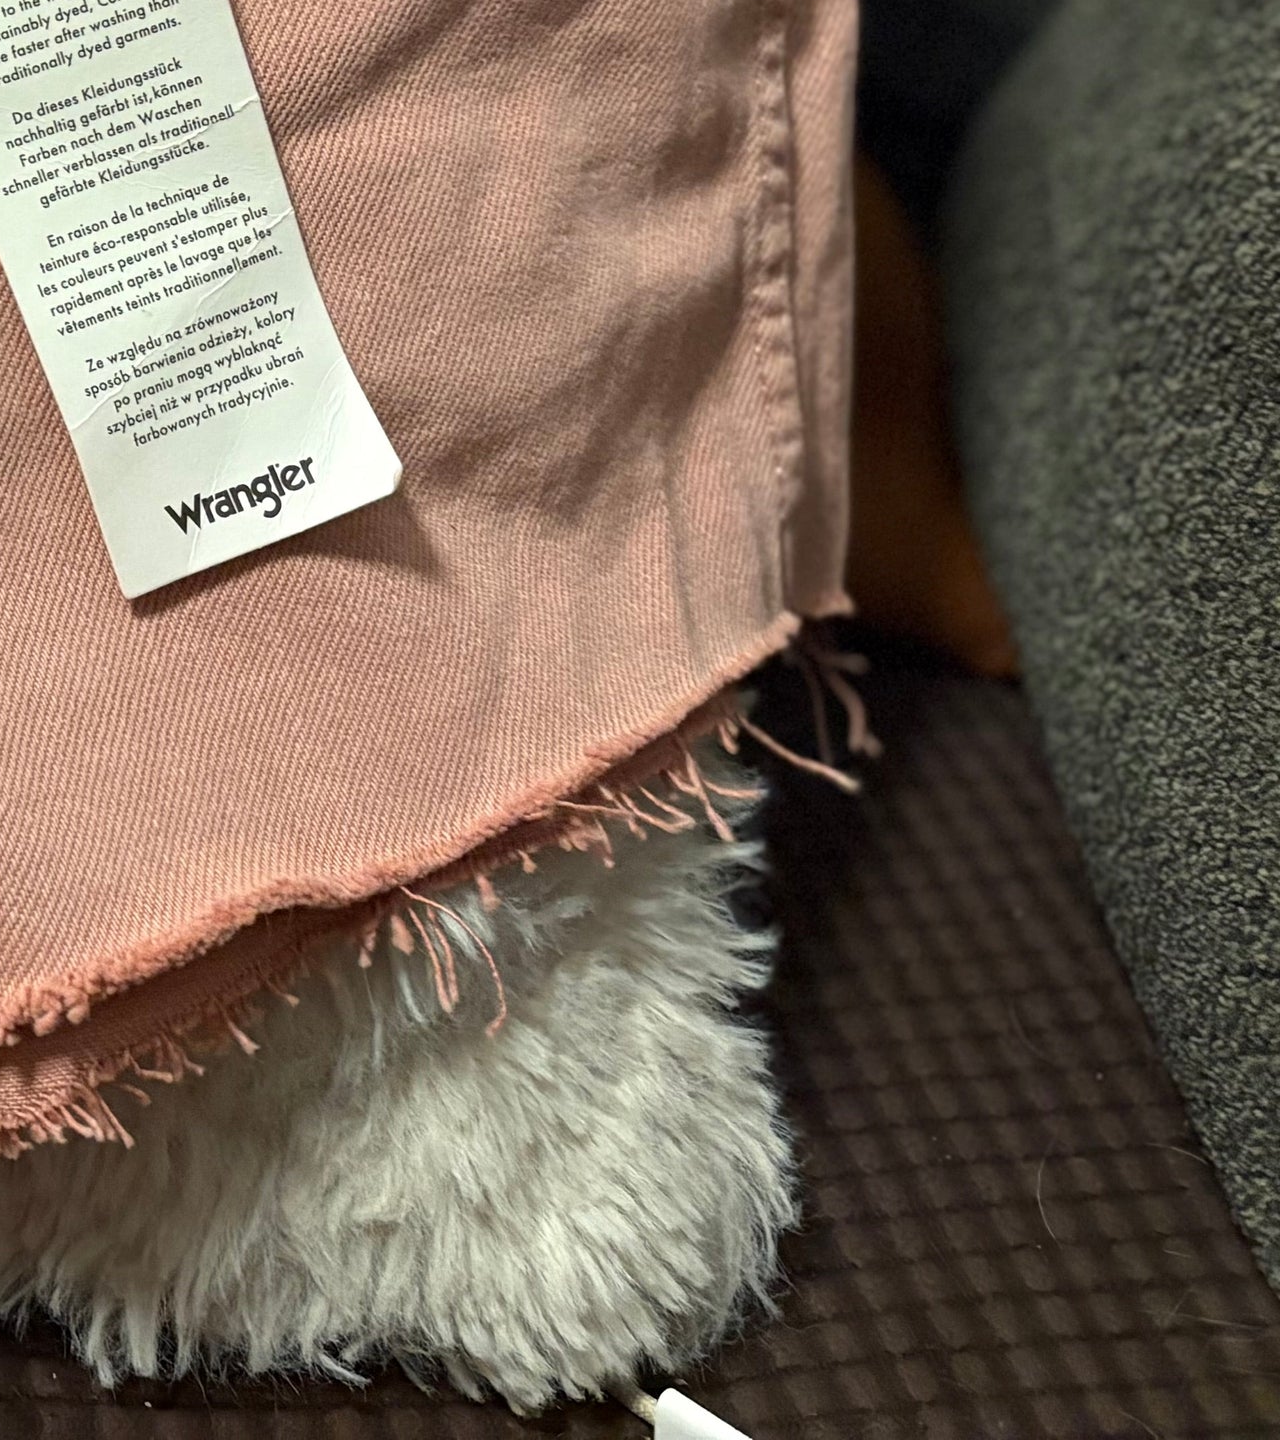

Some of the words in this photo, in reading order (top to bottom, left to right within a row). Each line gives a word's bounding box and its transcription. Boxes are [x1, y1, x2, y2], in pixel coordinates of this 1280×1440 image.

[0, 6, 16, 18] to
[10, 38, 51, 59] faster
[53, 26, 86, 45] after
[88, 6, 147, 33] washing
[77, 35, 113, 60] dyed
[115, 17, 182, 50] garments.
[5, 118, 77, 150] nachhaltig
[79, 97, 130, 128] gefärbt
[11, 111, 34, 126] Da
[36, 95, 80, 117] dieses
[80, 56, 183, 102] Kleidungsstück
[1, 168, 60, 197] schneller
[62, 143, 136, 174] verblassen
[137, 131, 159, 149] als
[159, 103, 236, 142] traditionell
[18, 144, 68, 168] Farben
[70, 128, 104, 151] nach
[106, 120, 137, 138] dem
[136, 98, 202, 126] Waschen
[39, 178, 96, 209] gefärbte
[97, 134, 210, 185] Kleidungsstücke.
[39, 249, 90, 274] teinture
[92, 207, 199, 255] éco-responsable
[200, 191, 251, 215] utilisée,
[46, 234, 66, 249] En
[67, 219, 109, 242] raison
[110, 210, 128, 225] de
[128, 204, 145, 219] la
[145, 183, 210, 213] technique
[212, 173, 230, 189] de
[36, 283, 59, 298] les
[60, 262, 116, 290] couleurs
[116, 240, 169, 273] peuvent
[170, 216, 238, 249] s'estomper
[241, 206, 268, 227] plus
[49, 280, 125, 317] rapidement
[126, 267, 164, 289] après
[163, 260, 179, 275] le
[178, 245, 225, 269] lavage
[227, 235, 252, 253] que
[252, 227, 272, 241] les
[56, 305, 124, 337] vêtements
[124, 291, 162, 312] teints
[162, 244, 283, 298] traditionnellement.
[84, 369, 132, 400] sposób
[131, 345, 197, 379] barwienia
[198, 325, 253, 353] odzieży,
[253, 307, 295, 330] kolory
[85, 358, 105, 373] Ze
[106, 335, 163, 365] względu
[164, 329, 183, 344] na
[184, 291, 278, 336] zrównoważony
[106, 403, 159, 435] szybciej
[159, 396, 180, 414] niż
[180, 393, 192, 404] w
[194, 364, 263, 404] przypadku
[265, 346, 305, 371] ubrań
[112, 395, 132, 413] po
[133, 377, 174, 405] praniu
[176, 363, 213, 384] mogą
[213, 331, 283, 369] wyblaknąć
[132, 403, 217, 448] farbowanych
[217, 377, 295, 413] tradycyjnie.
[163, 456, 316, 535] Wrangler
